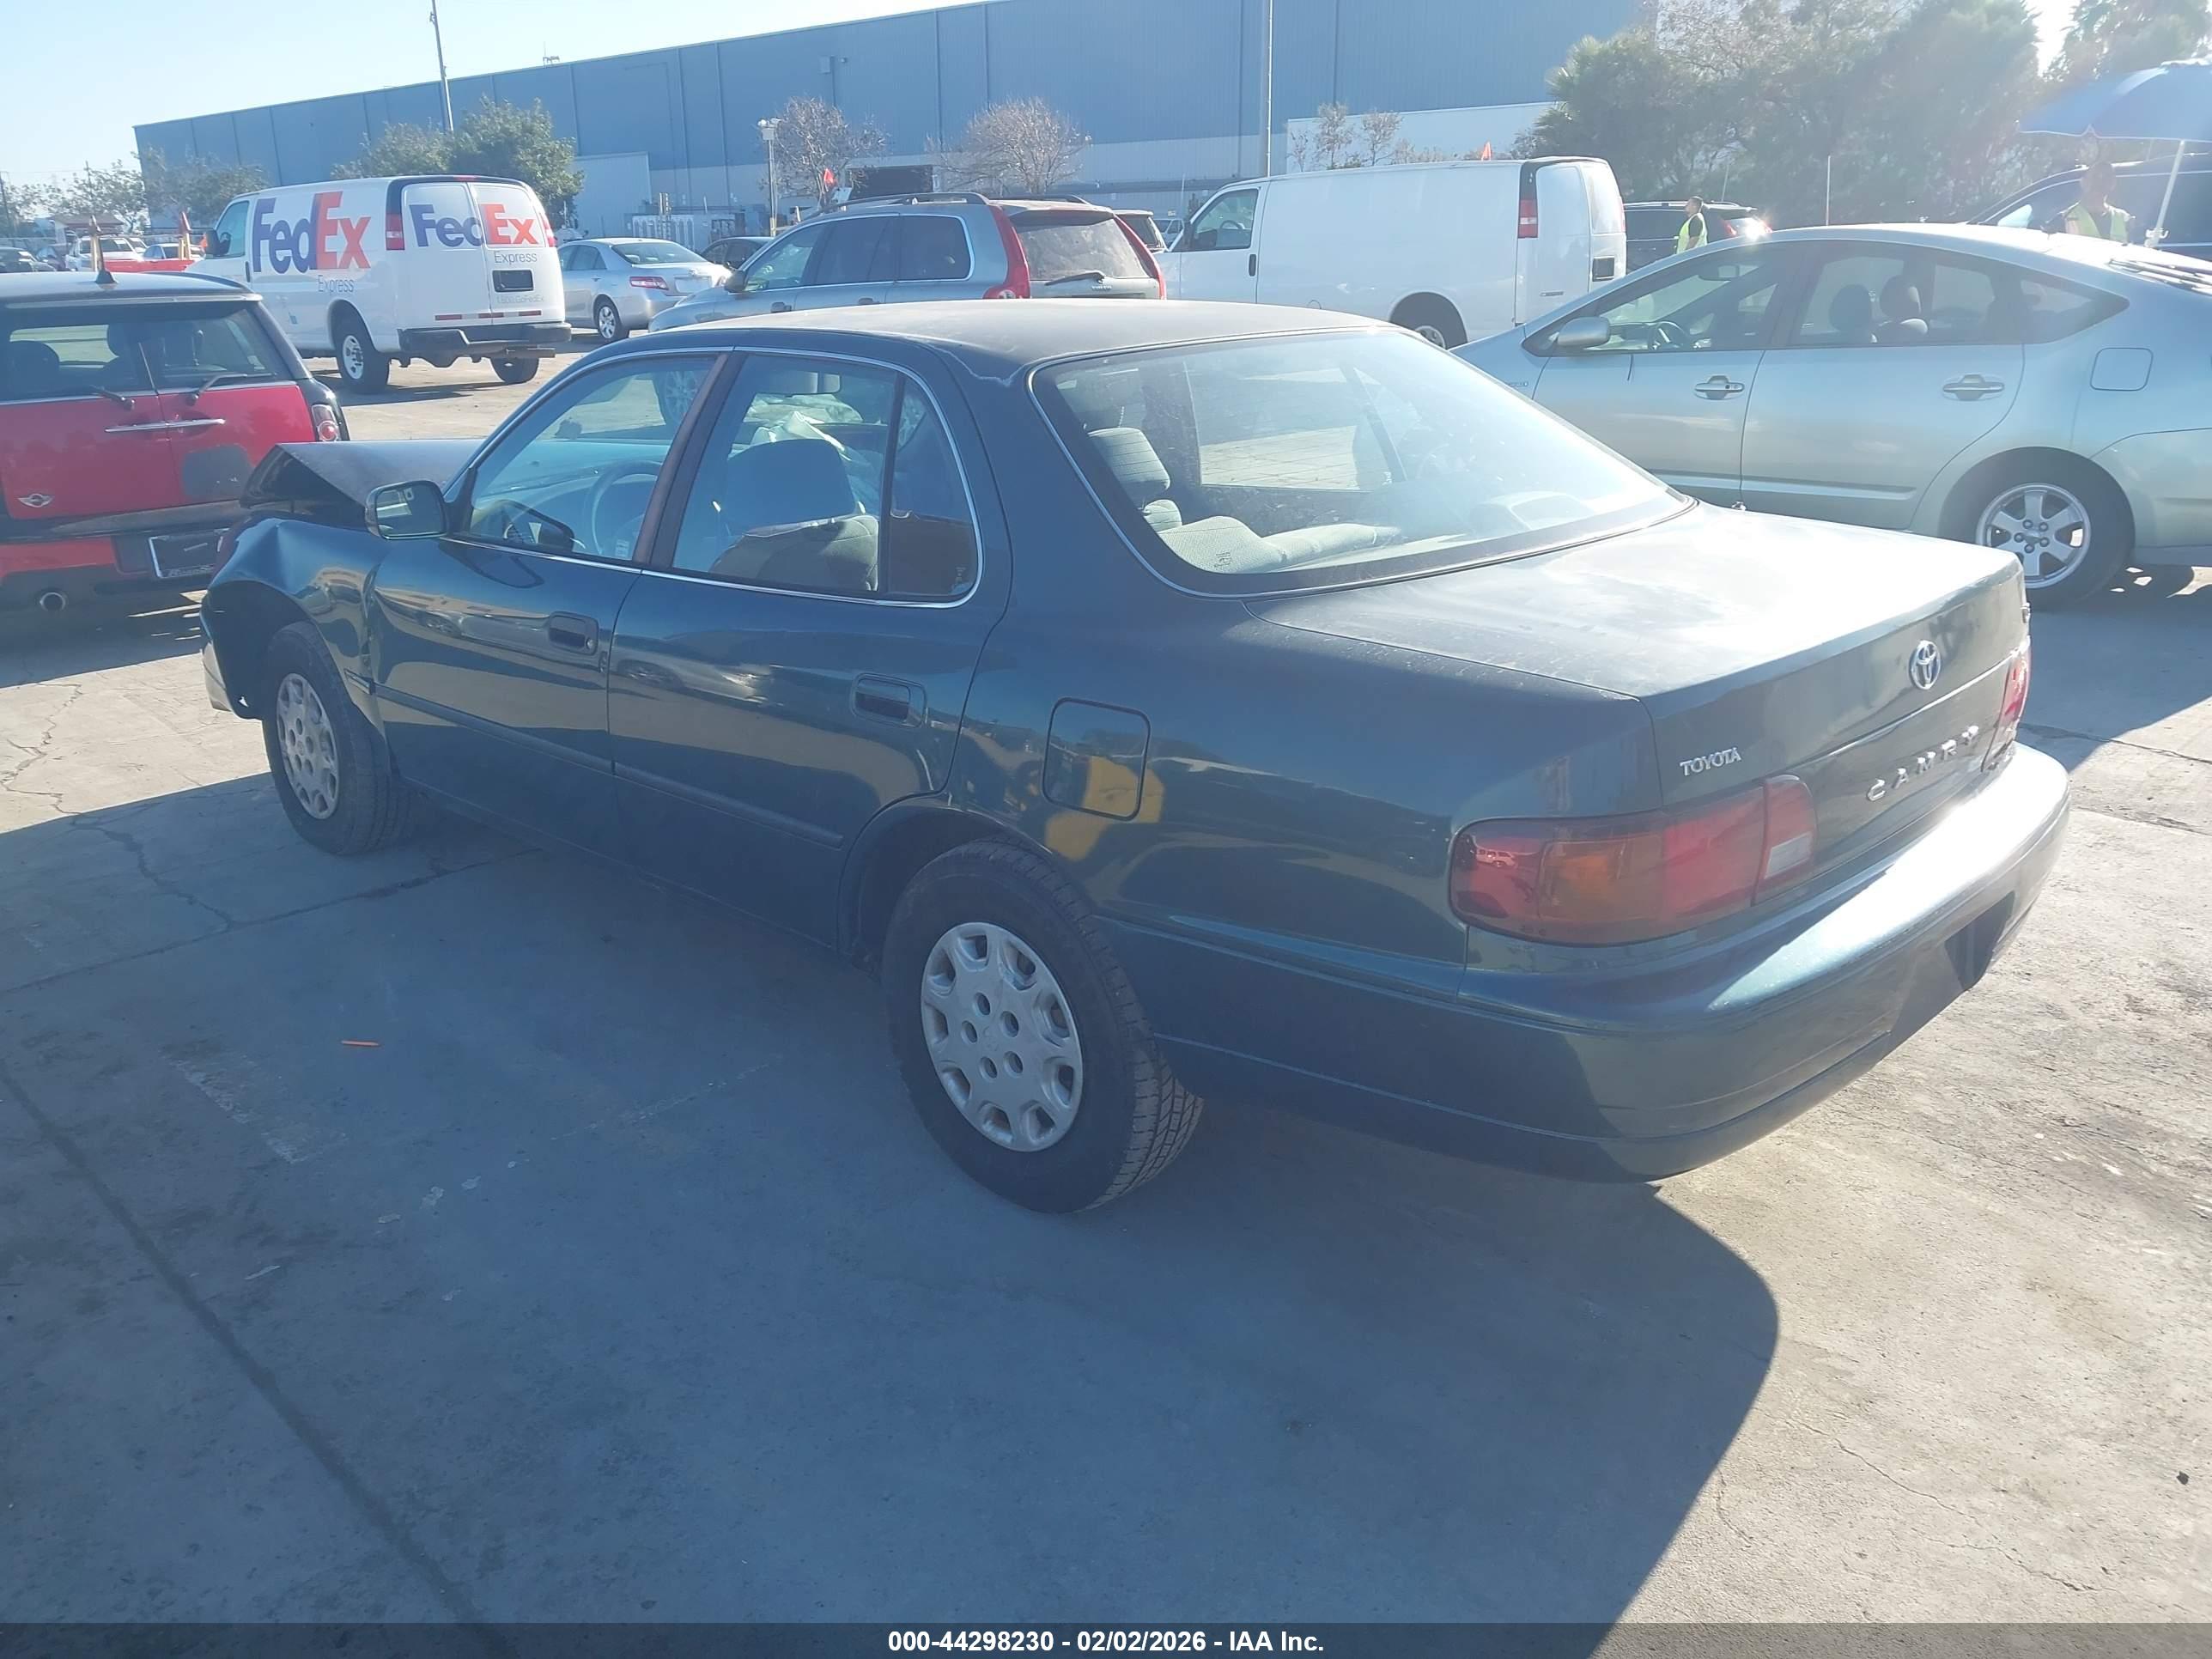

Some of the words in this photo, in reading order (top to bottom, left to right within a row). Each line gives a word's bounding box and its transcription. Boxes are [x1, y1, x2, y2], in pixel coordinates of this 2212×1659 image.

[252, 191, 372, 274] FedEx
[409, 204, 539, 247] FedEx
[494, 251, 538, 265] Express
[317, 275, 355, 295] Express
[1680, 746, 1742, 776] TOYOTA
[1867, 725, 1979, 802] CAMRY
